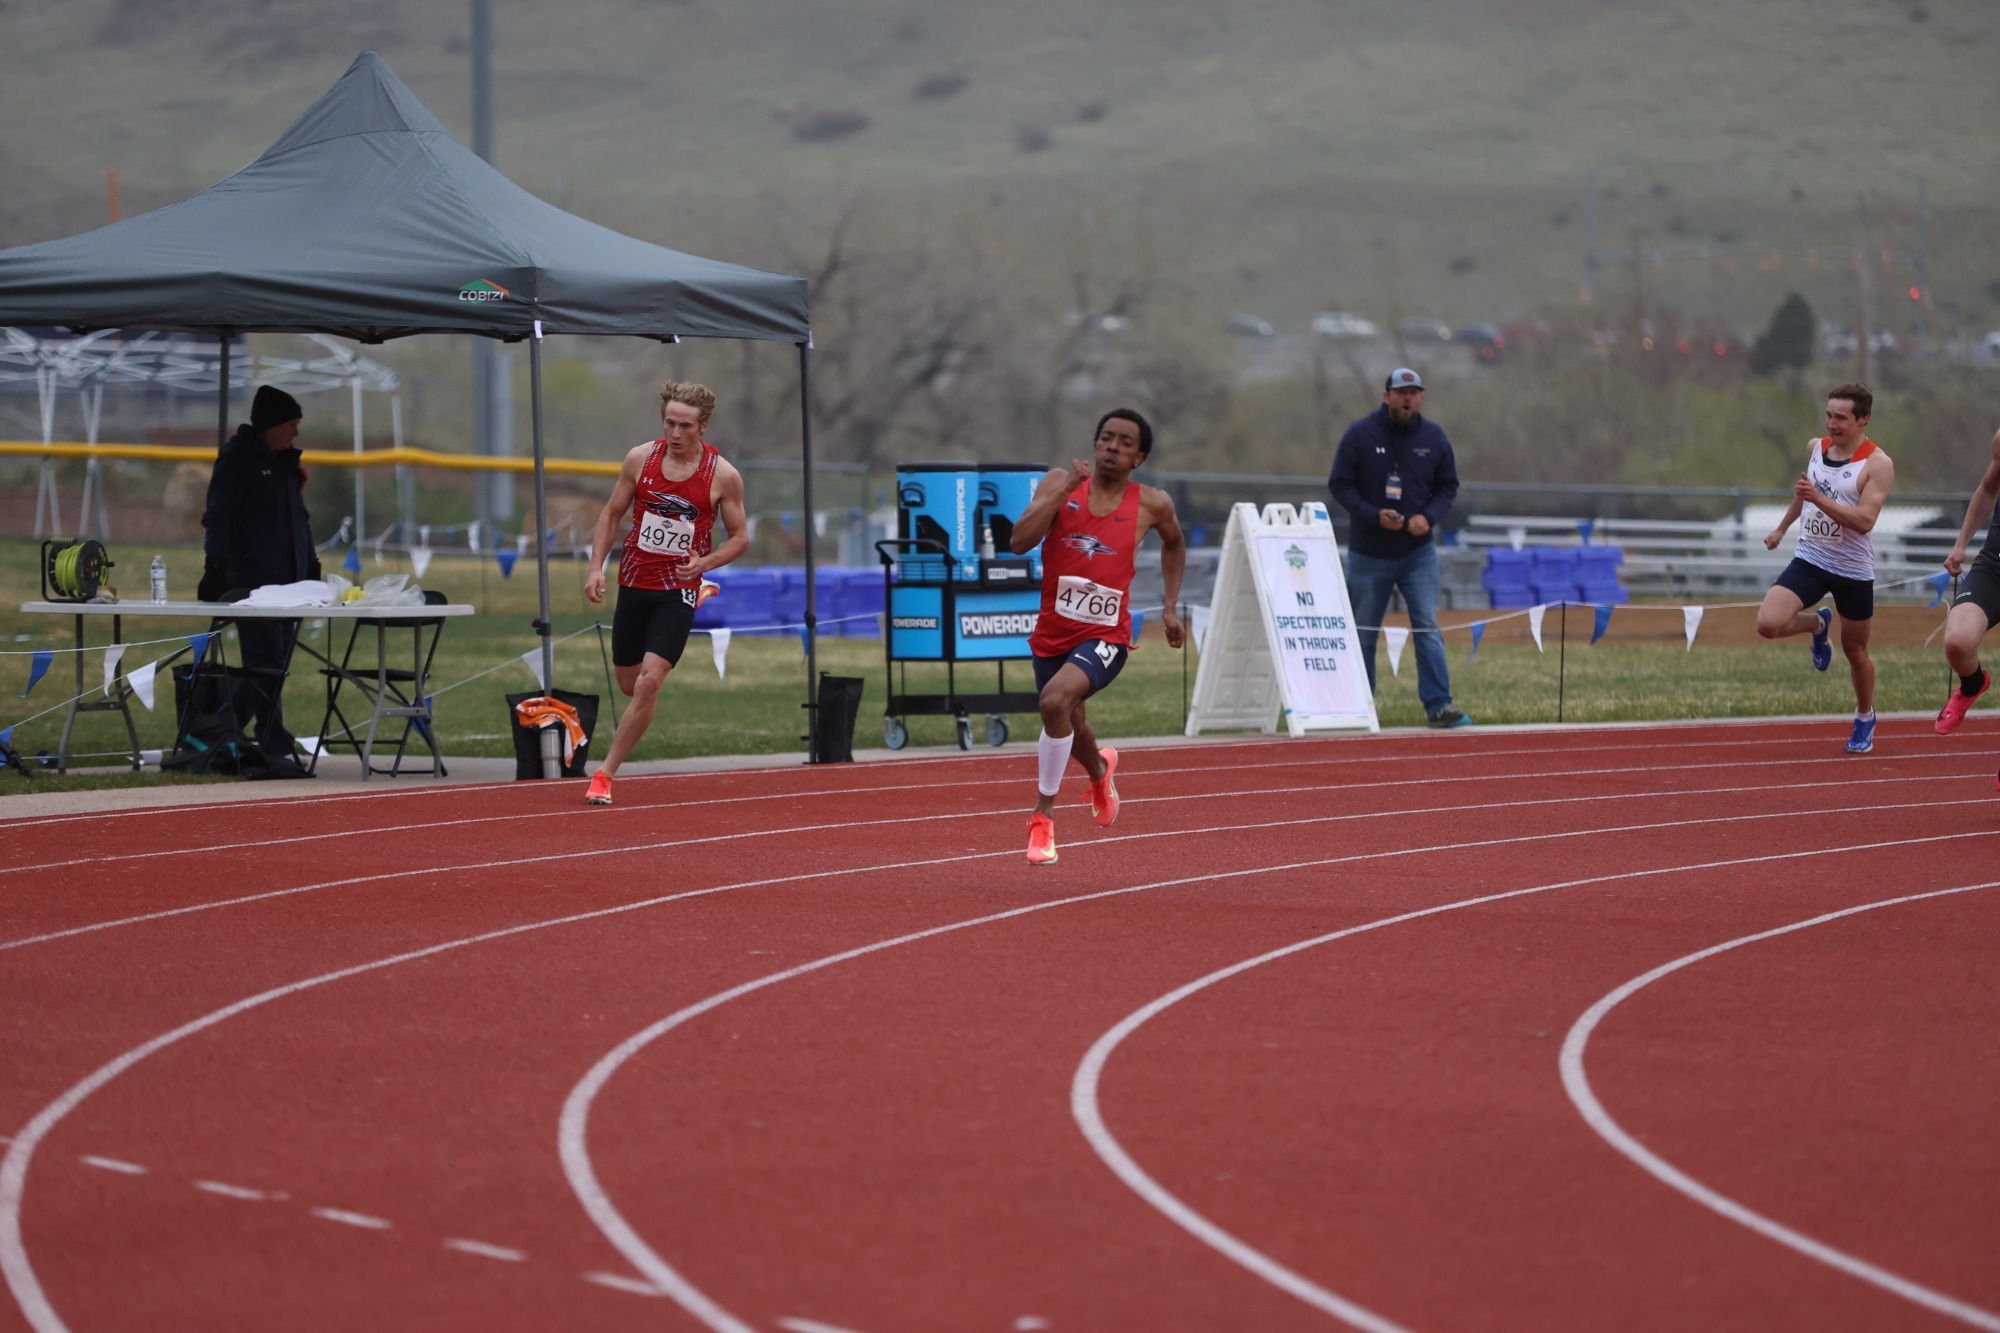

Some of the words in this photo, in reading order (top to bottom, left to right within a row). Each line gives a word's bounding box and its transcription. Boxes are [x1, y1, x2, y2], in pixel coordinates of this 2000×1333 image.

[956, 478, 966, 551] POWERADE
[1804, 518, 1841, 537] 4602
[641, 525, 691, 550] 4978
[1059, 588, 1118, 616] 4766
[1296, 591, 1315, 606] NO
[1276, 616, 1346, 630] SPECTATORS
[1284, 638, 1297, 650] IN
[1299, 637, 1346, 650] THROWS
[1303, 657, 1337, 671] FIELD
